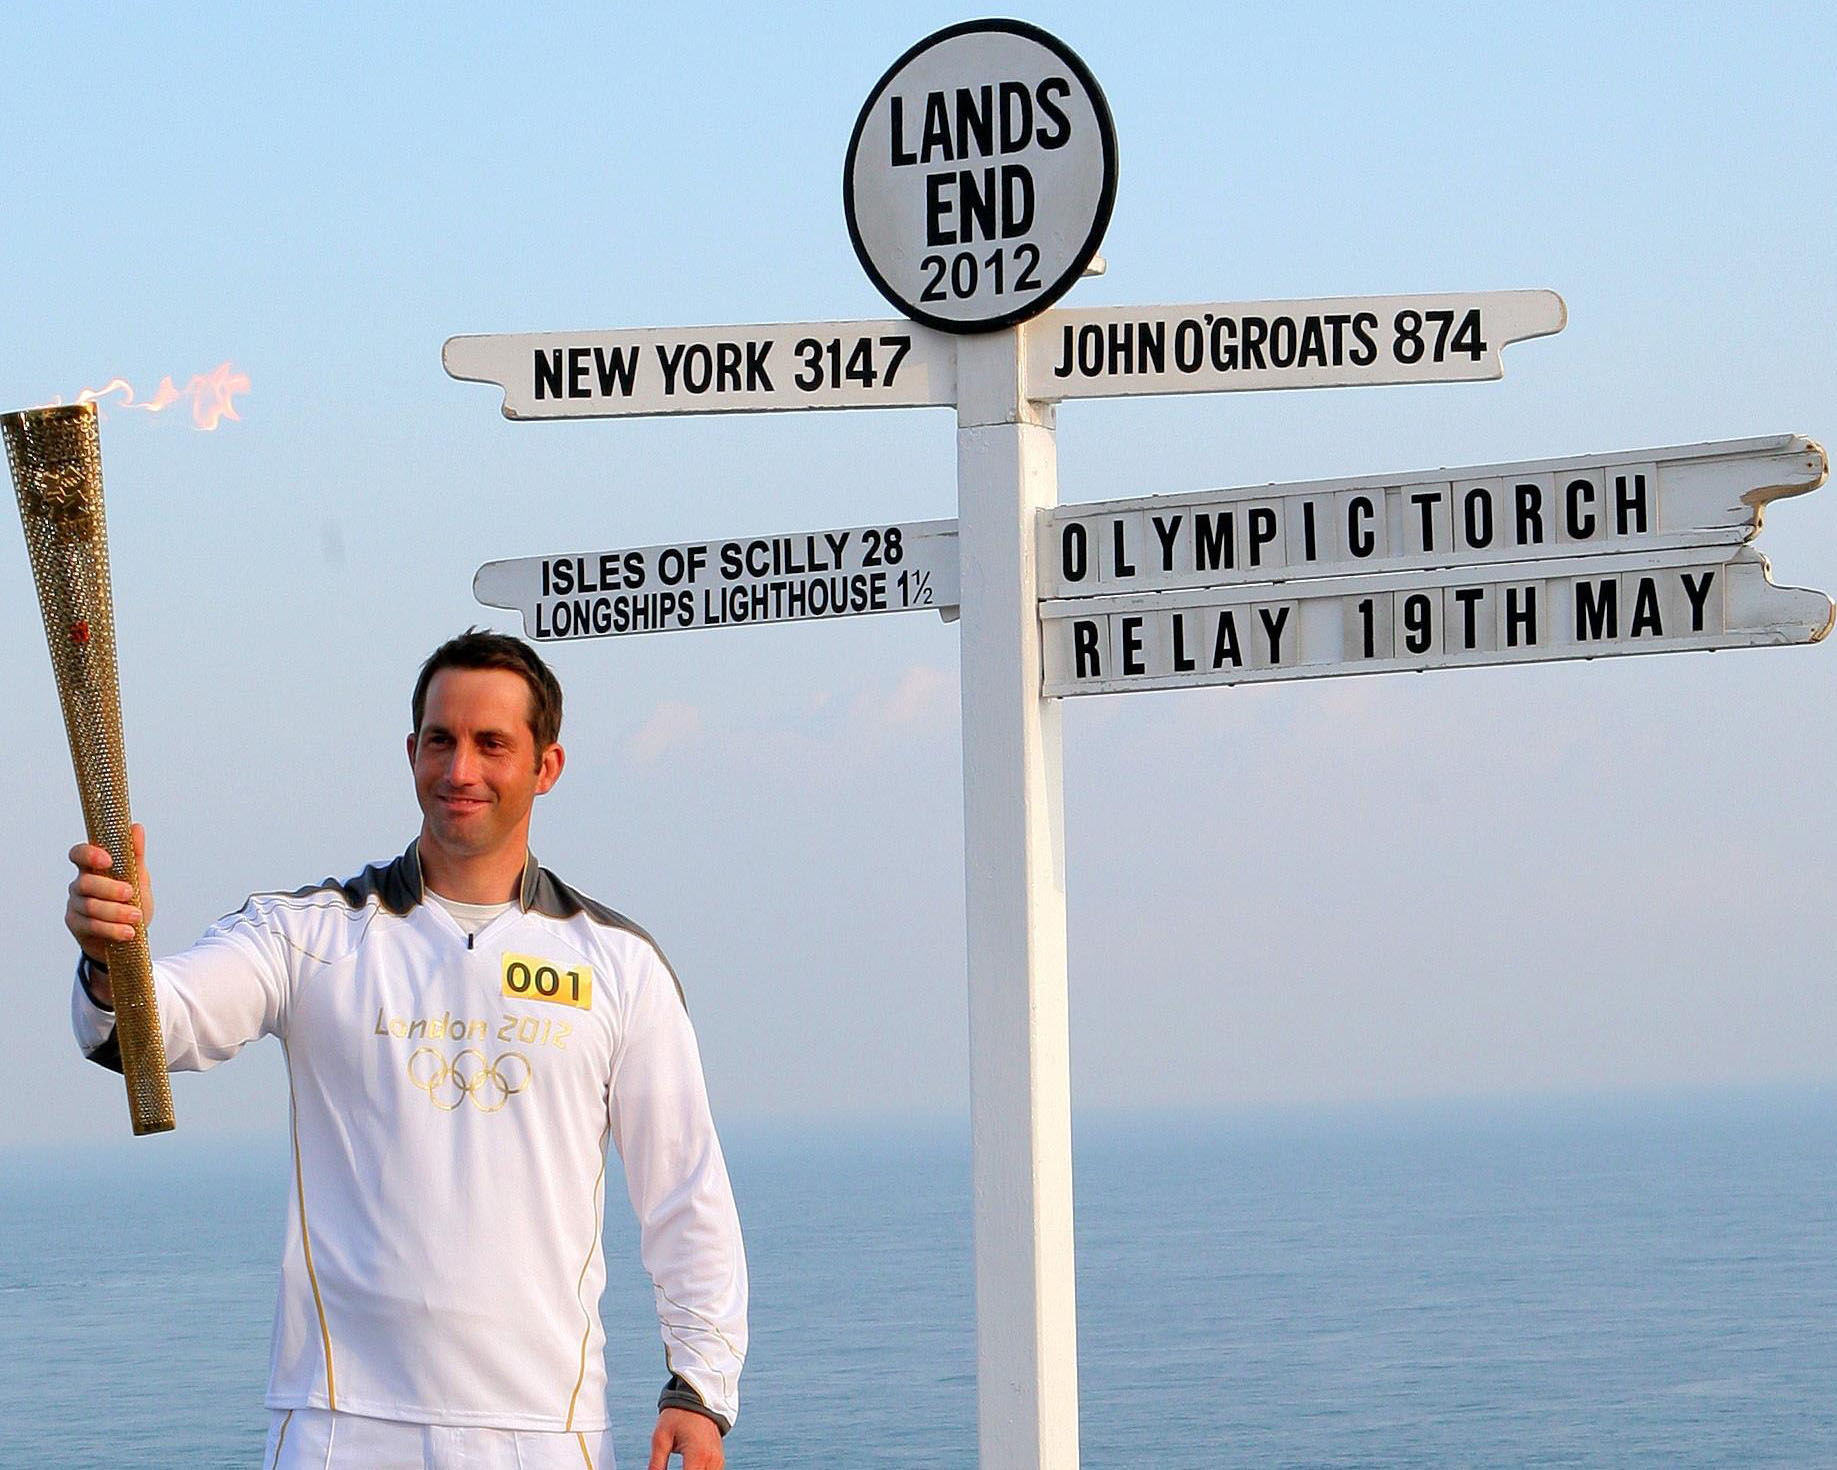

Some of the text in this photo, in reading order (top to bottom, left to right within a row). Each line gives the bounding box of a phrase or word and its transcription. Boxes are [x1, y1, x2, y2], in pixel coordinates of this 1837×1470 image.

[890, 77, 1071, 167] LANDS
[926, 163, 1035, 247] END
[919, 243, 1041, 302] 2012
[534, 335, 911, 399] NEW YORK 3147
[1054, 309, 1487, 377] JOHN O'GROATS 874
[1062, 473, 1648, 582] OLYMPIC TORCH
[542, 527, 903, 597] ISLES OF SCILLY 28
[535, 591, 694, 638] LONGSHIPS
[704, 573, 886, 624] LIGHTHOUSE
[1073, 571, 1716, 678] RELAY 19TH MAY
[506, 962, 579, 1001] 001
[374, 1007, 572, 1049] London 2012
